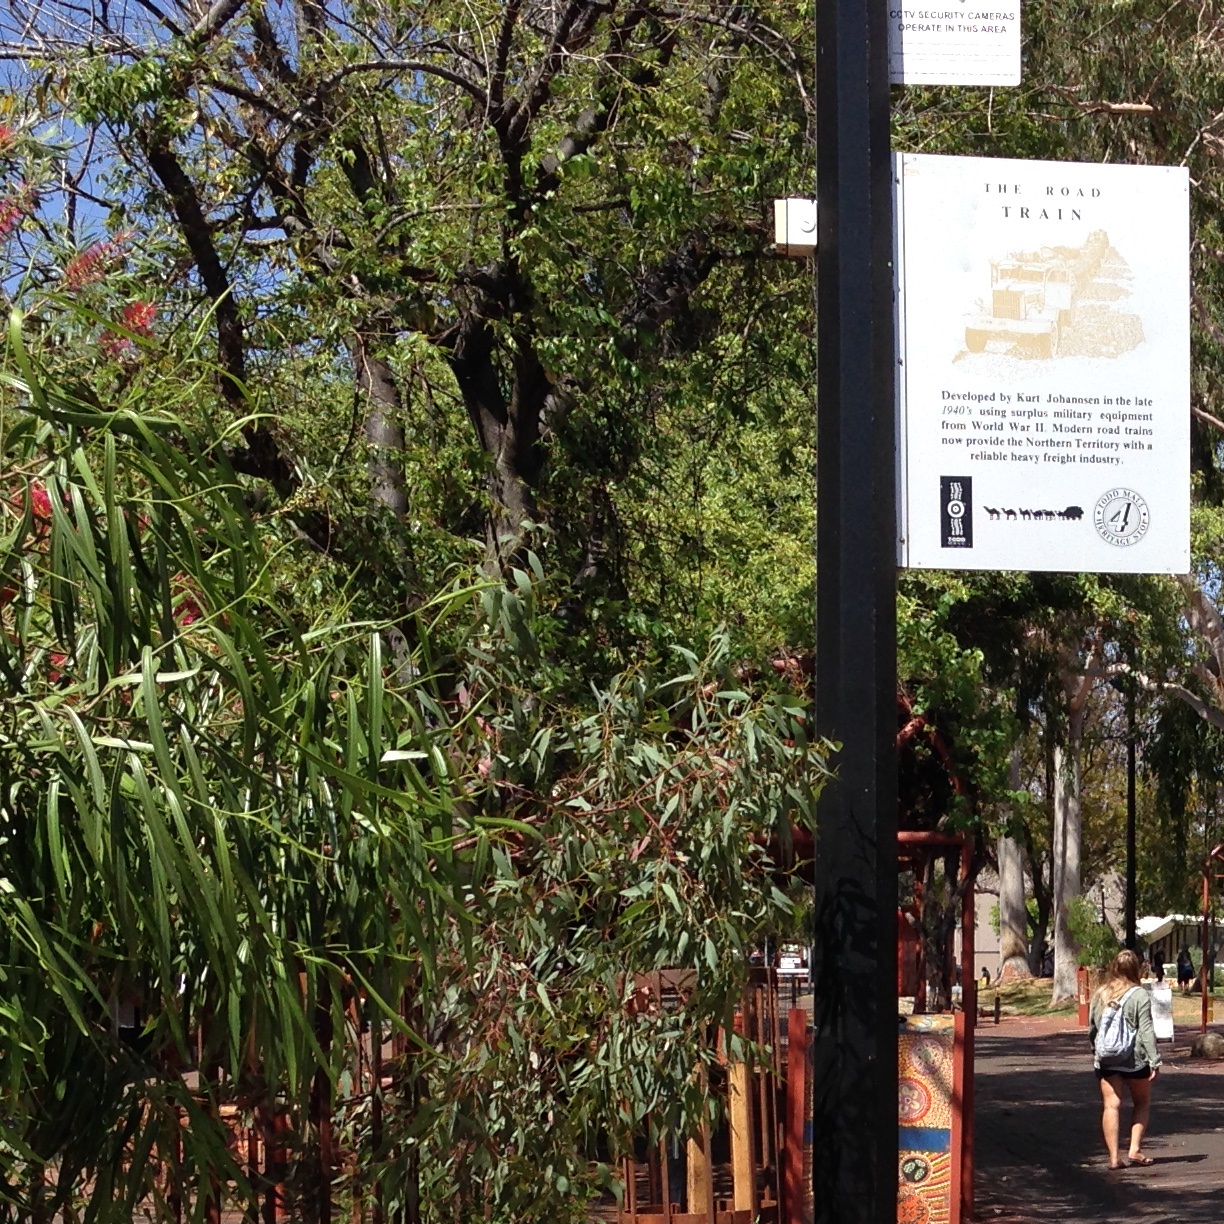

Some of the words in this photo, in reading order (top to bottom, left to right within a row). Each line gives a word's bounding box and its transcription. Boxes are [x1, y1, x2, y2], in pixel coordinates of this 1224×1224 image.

[890, 10, 915, 19] CCTV
[918, 10, 965, 20] SECURITY
[967, 11, 1015, 21] CAMERAS
[898, 23, 942, 32] OPERATE
[945, 24, 955, 33] IN
[957, 24, 979, 33] THIS
[980, 25, 1007, 33] AREA
[983, 182, 1021, 195] THE
[1046, 185, 1101, 198] ROAD
[1001, 205, 1081, 221] TRAIN
[941, 390, 995, 403] Developed
[999, 392, 1011, 404] by
[1016, 392, 1040, 403] Kurt
[1103, 395, 1113, 405] in
[1115, 396, 1132, 406] the
[1134, 396, 1153, 407] late
[941, 405, 972, 415] 1940's
[979, 406, 1007, 418] using
[1010, 408, 1048, 419] surplus
[1053, 409, 1092, 421] military
[1099, 410, 1153, 422] equipment
[941, 420, 966, 430] from
[971, 420, 1004, 431] World
[1008, 421, 1031, 432] War
[1052, 423, 1093, 433] Modern
[1097, 425, 1120, 435] road
[1124, 426, 1153, 436] trains
[941, 437, 962, 445] now
[966, 436, 1005, 447] provide
[1007, 437, 1023, 447] the
[1026, 437, 1072, 448] Northern
[1074, 438, 1120, 452] Territory
[1123, 440, 1145, 450] with
[970, 451, 1008, 461] reliable
[1010, 451, 1040, 464] heavy
[1043, 452, 1076, 465] freight
[1079, 453, 1124, 466] industry.
[1107, 502, 1132, 533] 4
